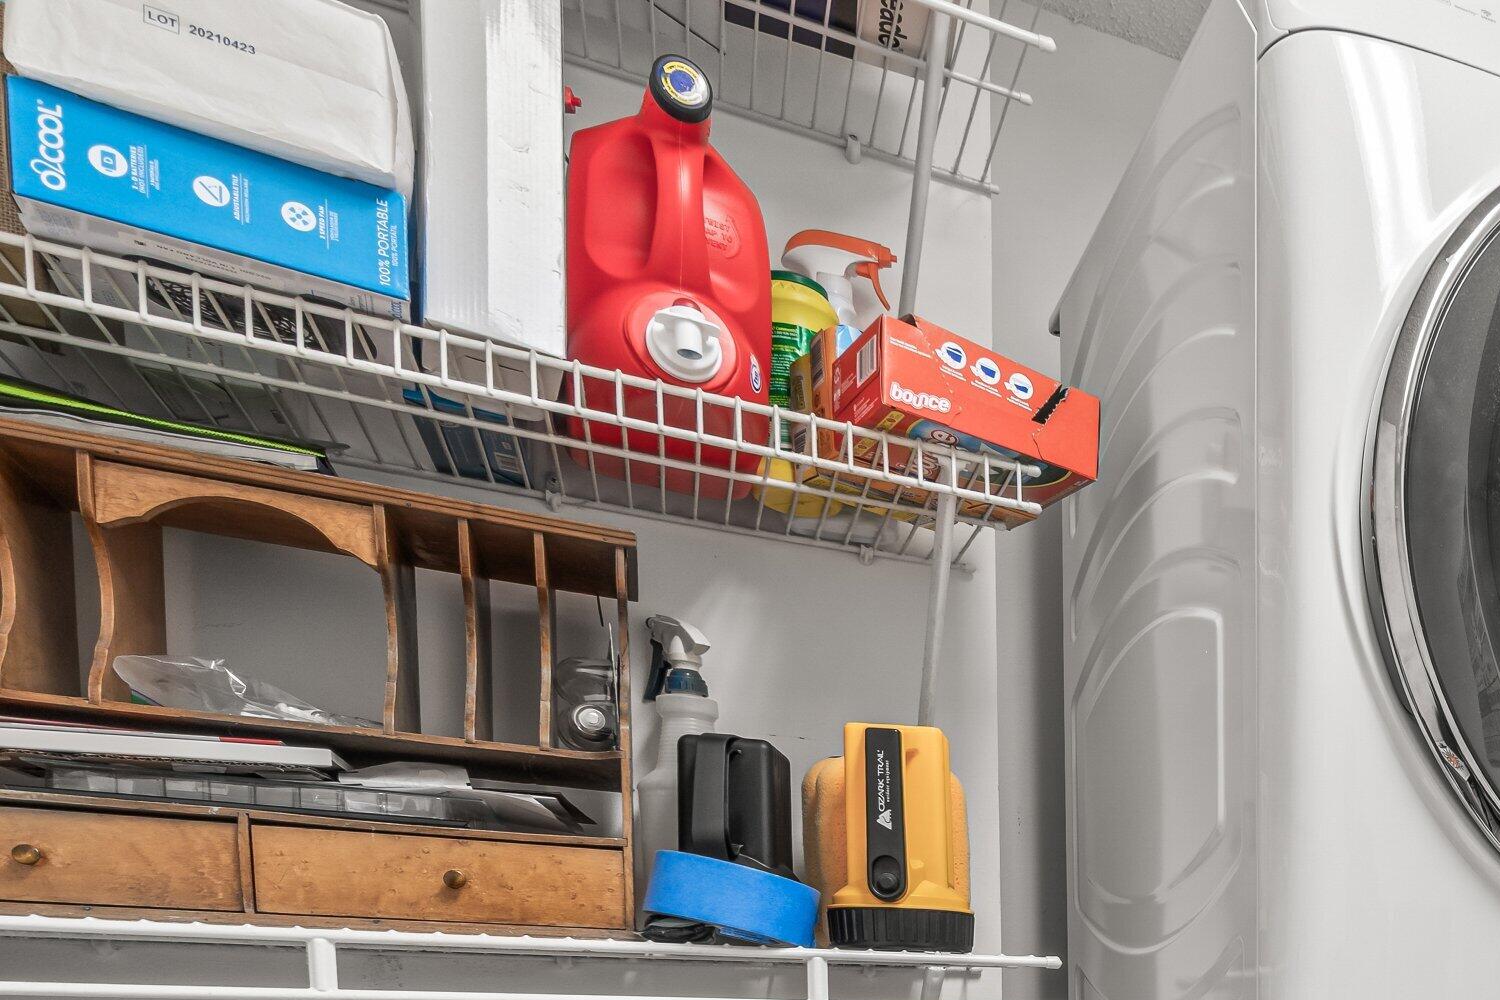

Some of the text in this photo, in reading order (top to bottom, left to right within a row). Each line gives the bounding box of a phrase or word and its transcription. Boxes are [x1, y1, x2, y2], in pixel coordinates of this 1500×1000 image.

[148, 10, 256, 55] LOT 20210423
[376, 198, 391, 286] 100% PORTABLE
[890, 381, 952, 413] bounce
[878, 778, 886, 812] OZARK
